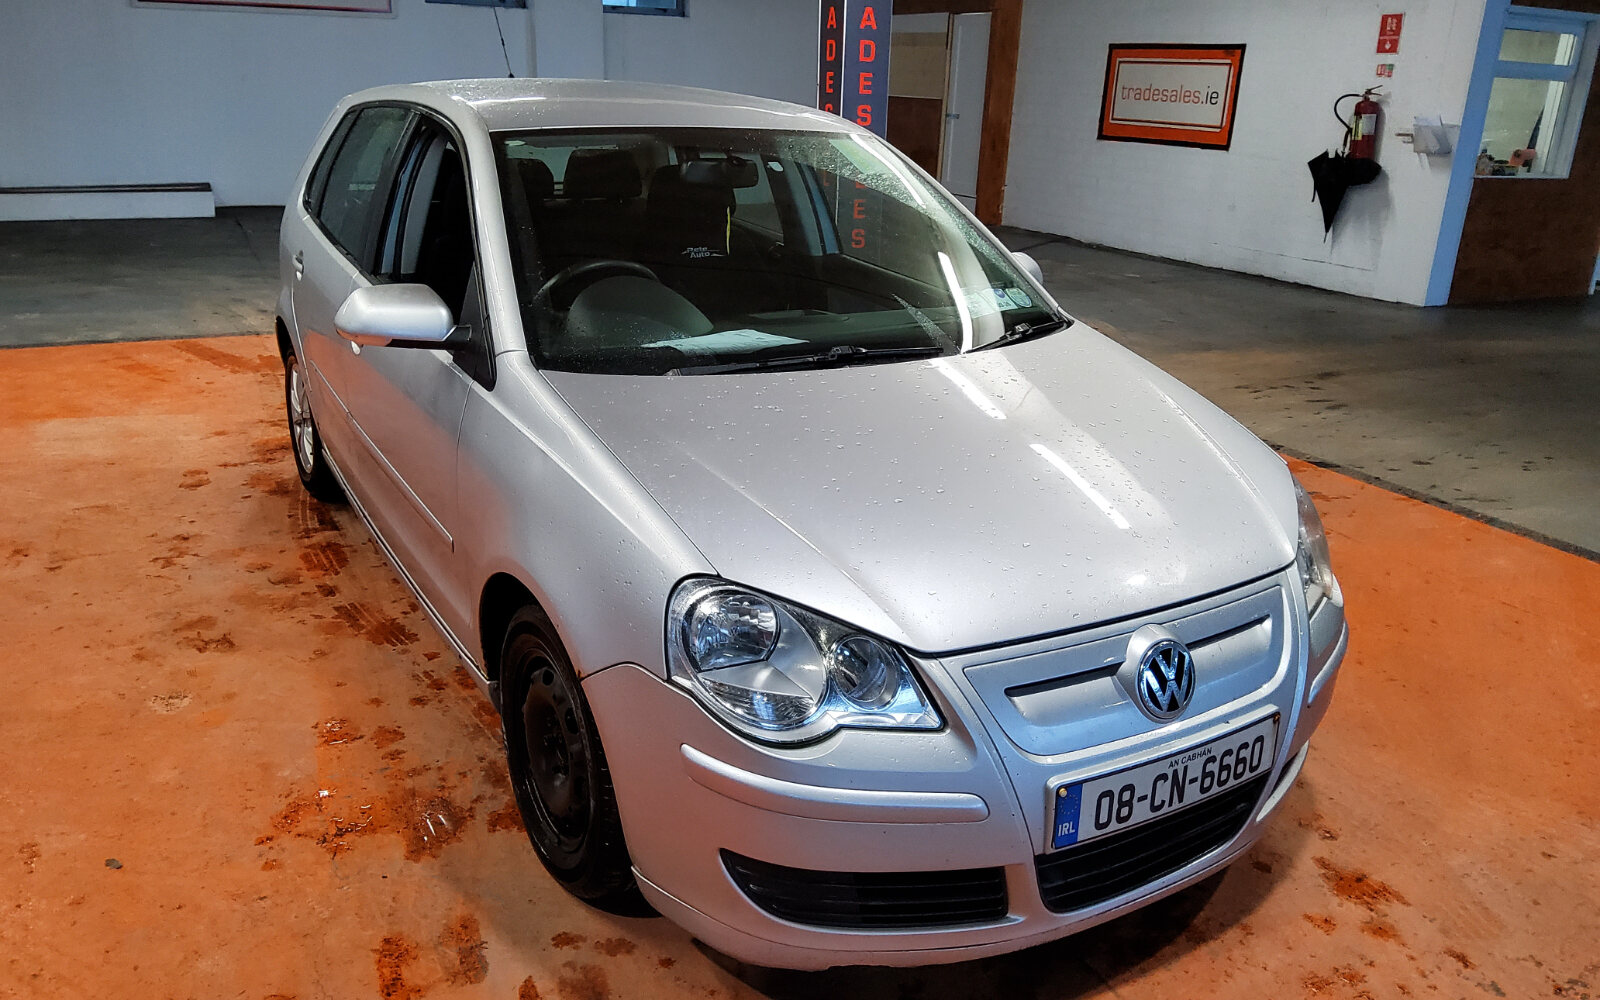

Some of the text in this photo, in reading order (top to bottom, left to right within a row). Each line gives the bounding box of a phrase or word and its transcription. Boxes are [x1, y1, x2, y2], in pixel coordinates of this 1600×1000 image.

[1121, 83, 1219, 106] tradesales.ie
[690, 251, 711, 259] Auto
[1168, 759, 1180, 769] AN
[1094, 735, 1265, 830] 08-CN-6660
[1057, 821, 1076, 837] IRL
